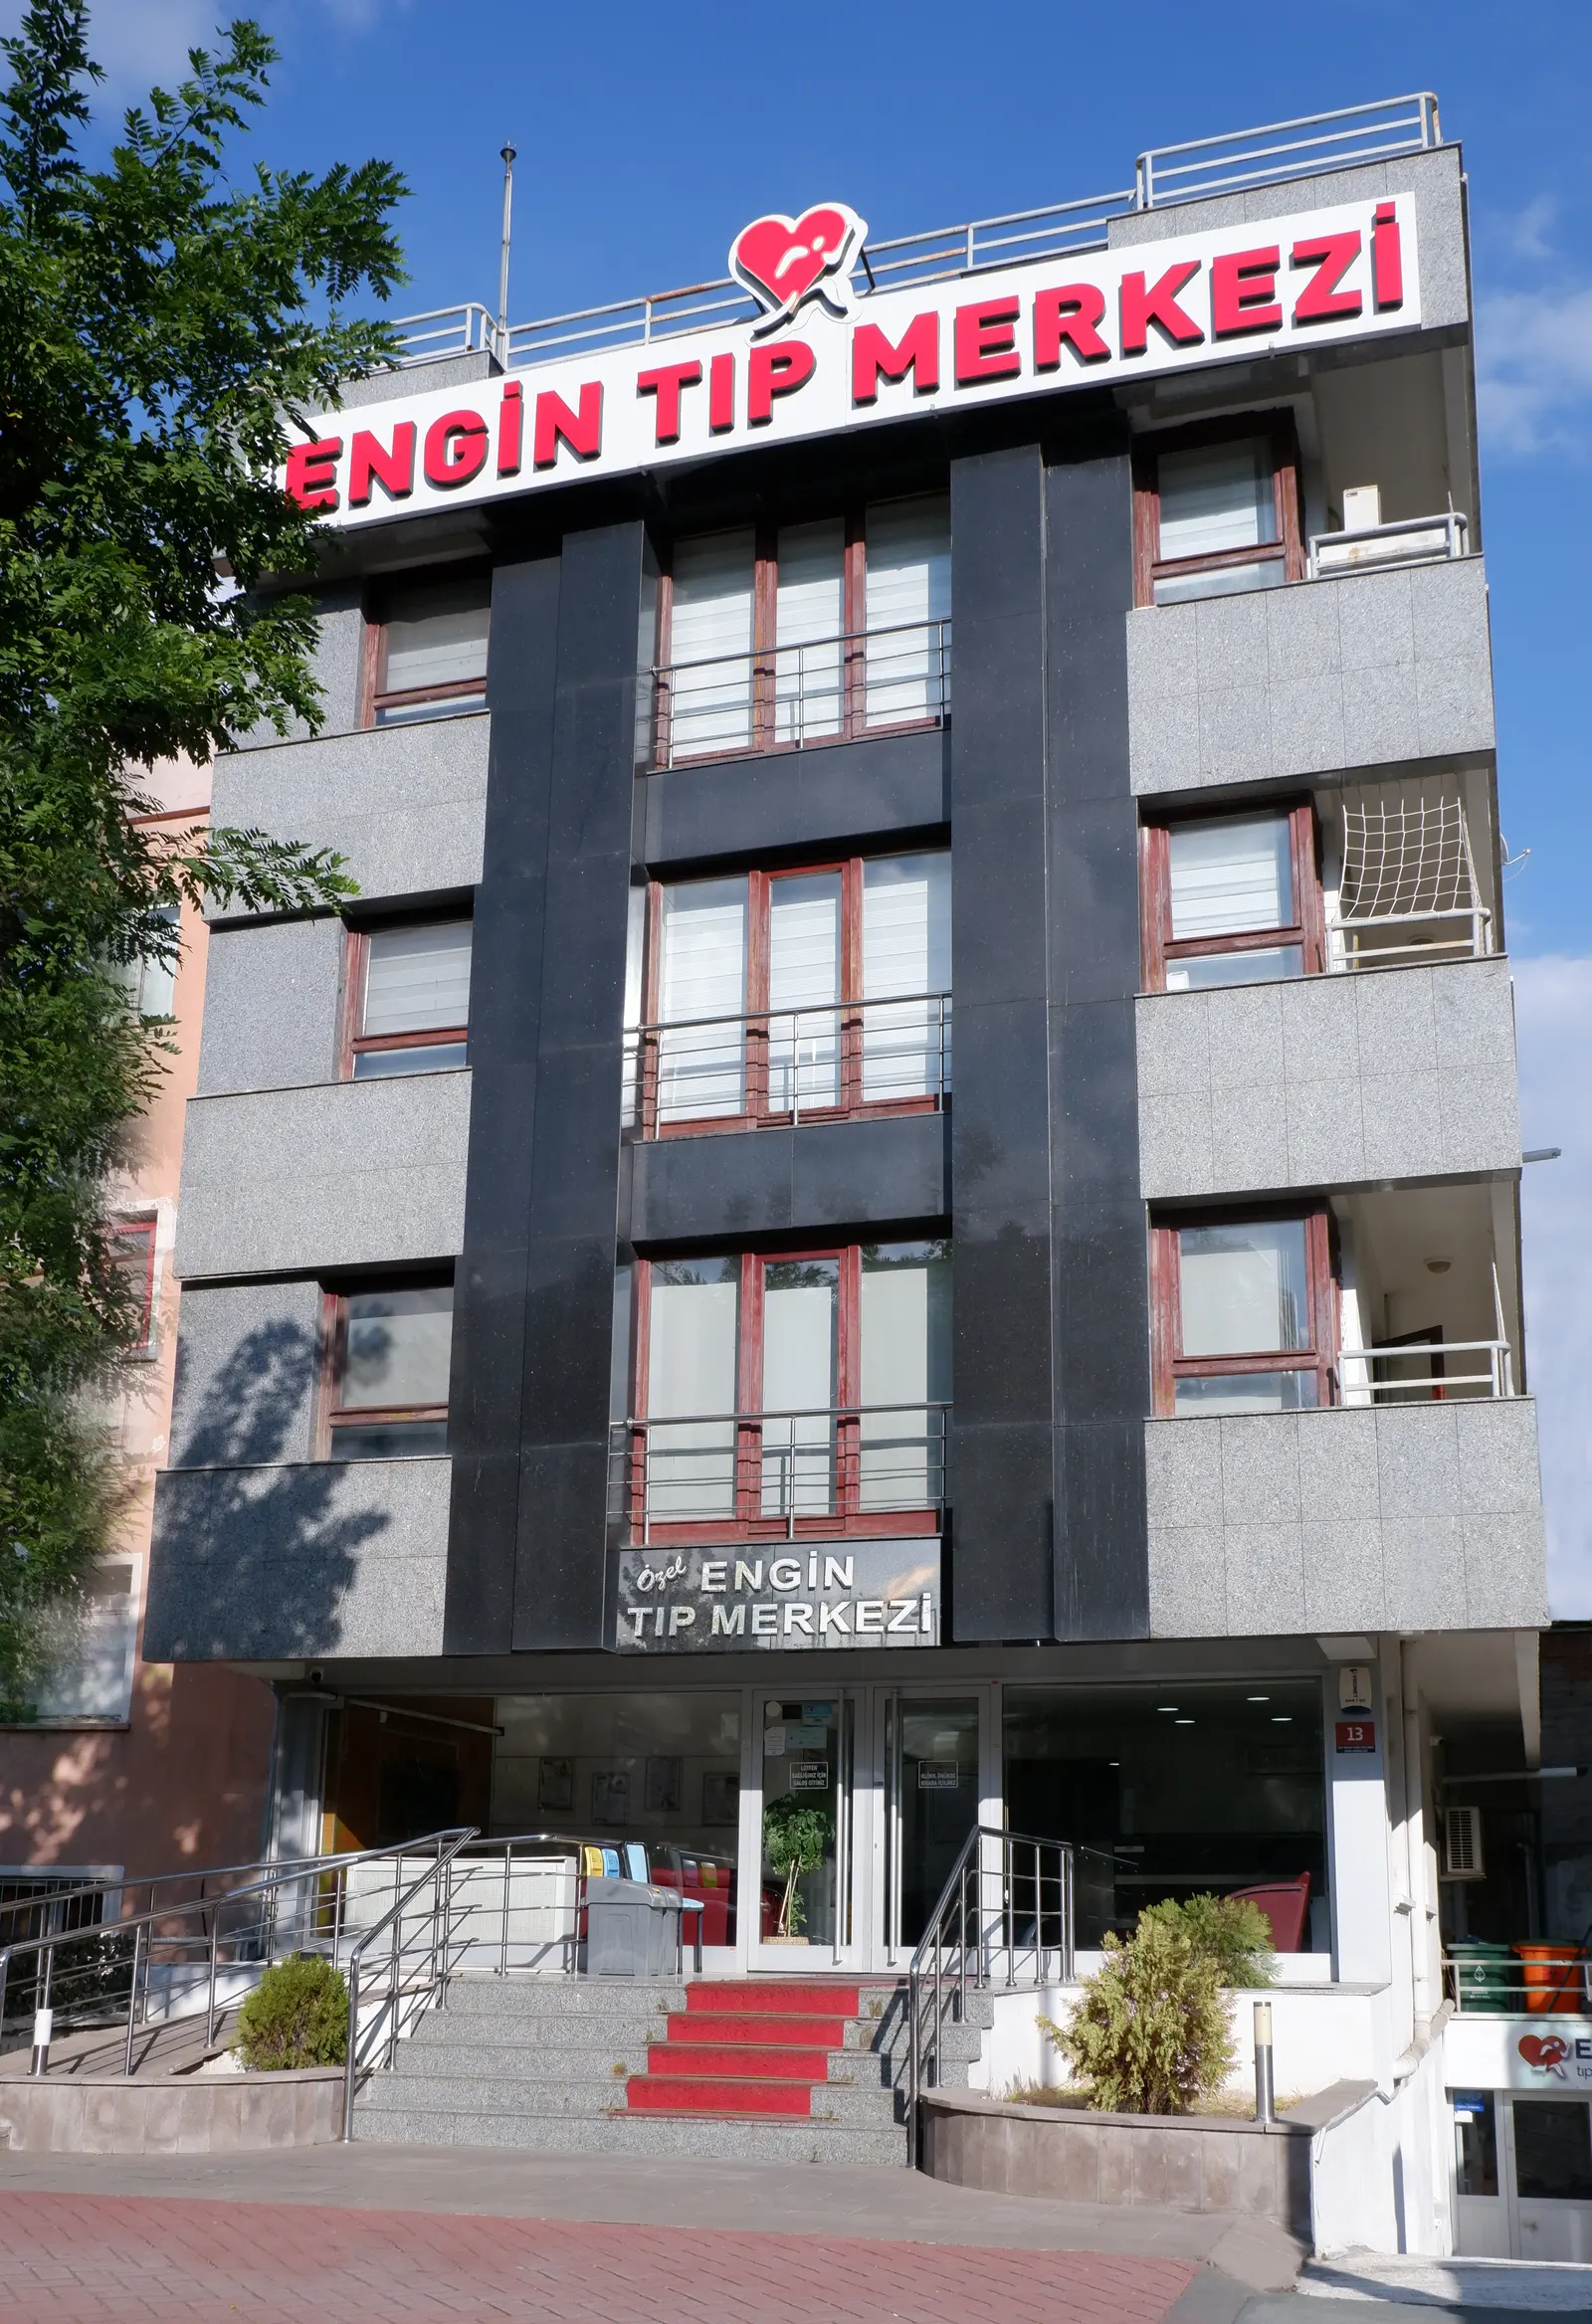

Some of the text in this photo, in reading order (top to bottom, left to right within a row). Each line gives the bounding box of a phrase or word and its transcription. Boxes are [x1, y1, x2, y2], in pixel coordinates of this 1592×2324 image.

[285, 201, 1403, 512] ENGİN TIP MERKEZİ
[637, 1550, 854, 1592] Özel ENGİN
[628, 1592, 932, 1638] TIP MERKEZİ
[1347, 1727, 1363, 1741] 13
